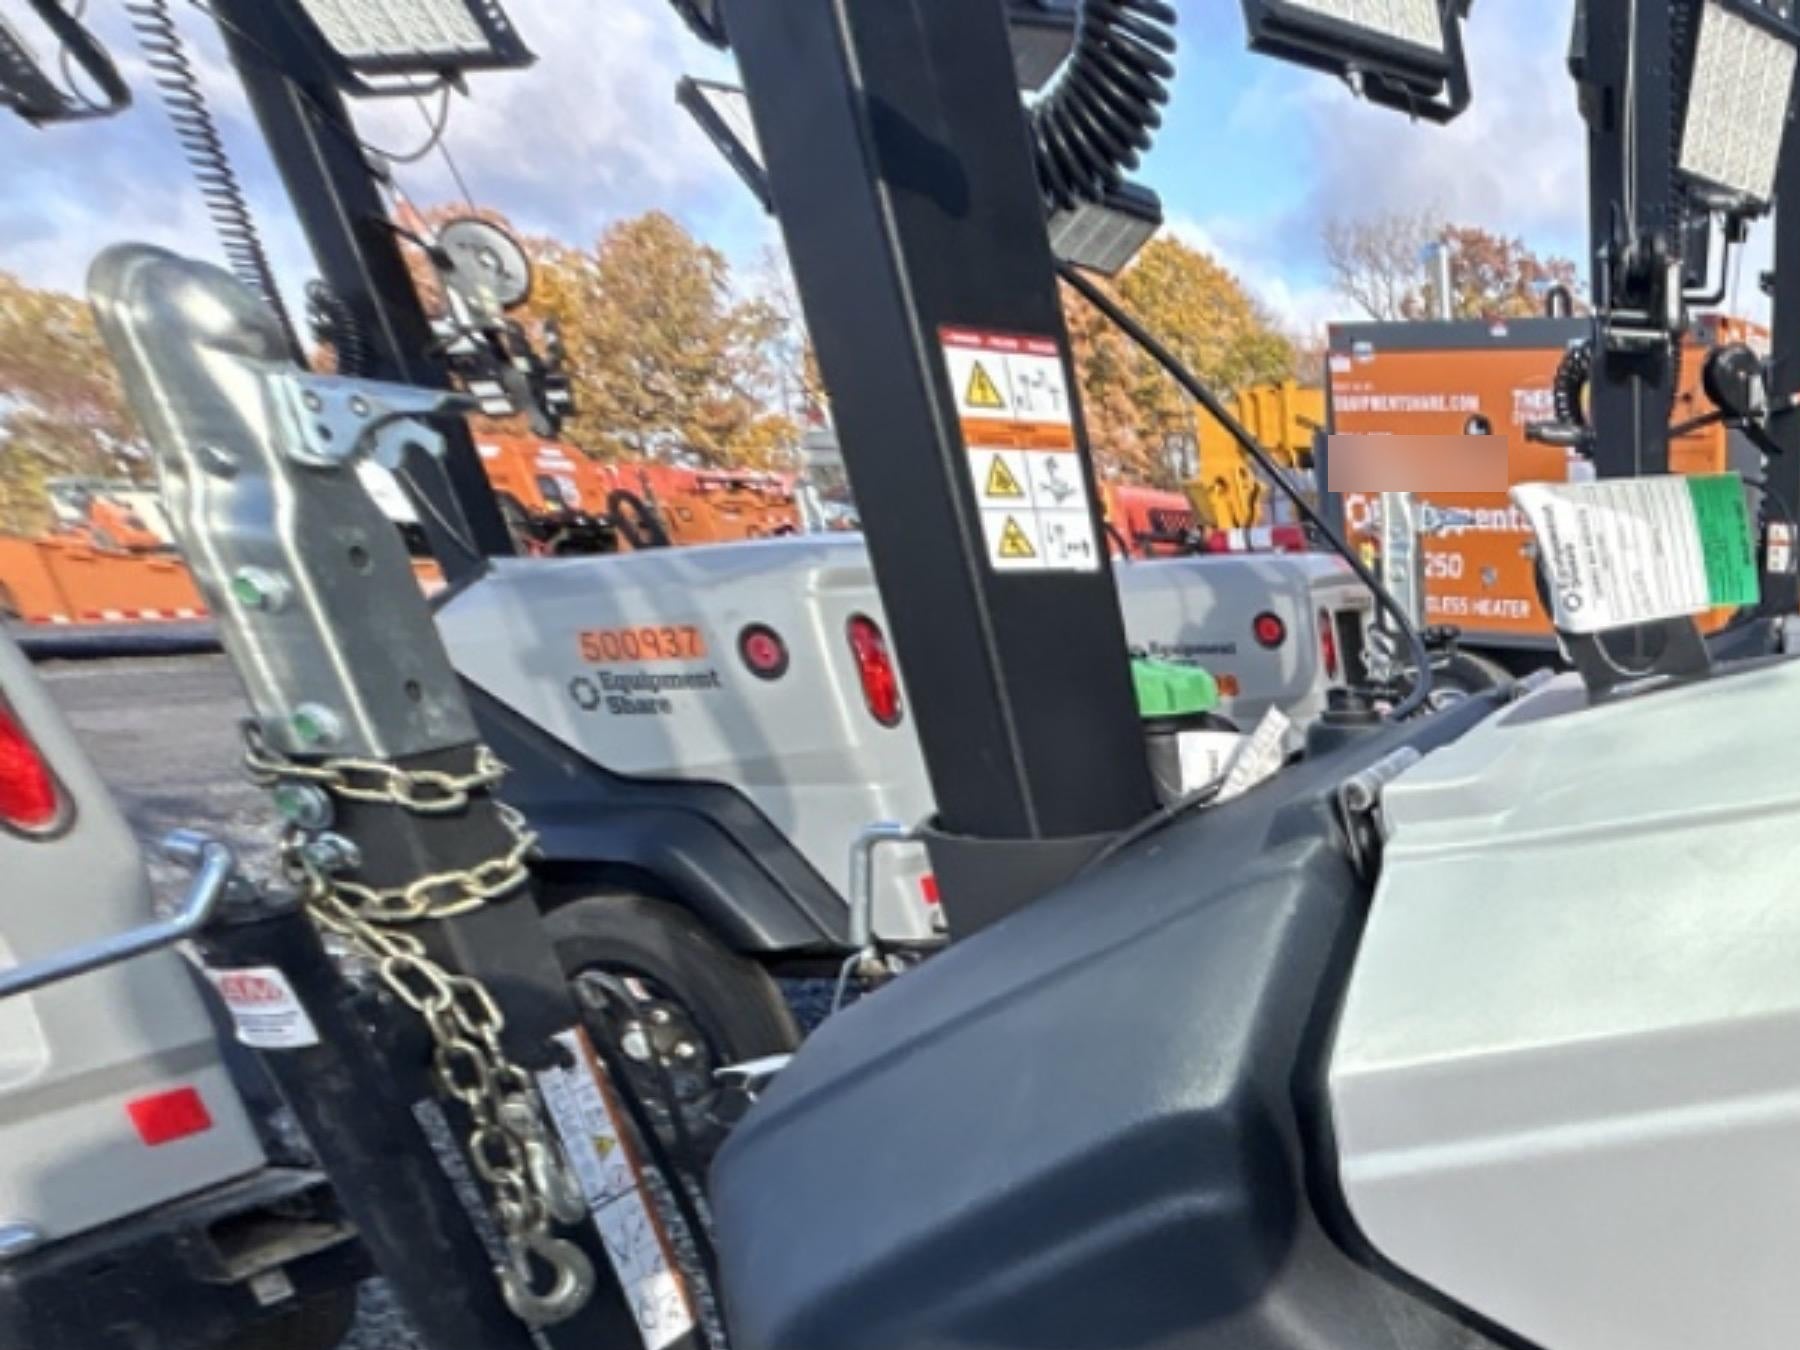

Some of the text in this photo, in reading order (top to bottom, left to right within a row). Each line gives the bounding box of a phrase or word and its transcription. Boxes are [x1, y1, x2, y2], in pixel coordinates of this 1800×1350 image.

[580, 626, 699, 662] 500937
[598, 669, 721, 695] Equipment
[606, 695, 673, 715] Share
